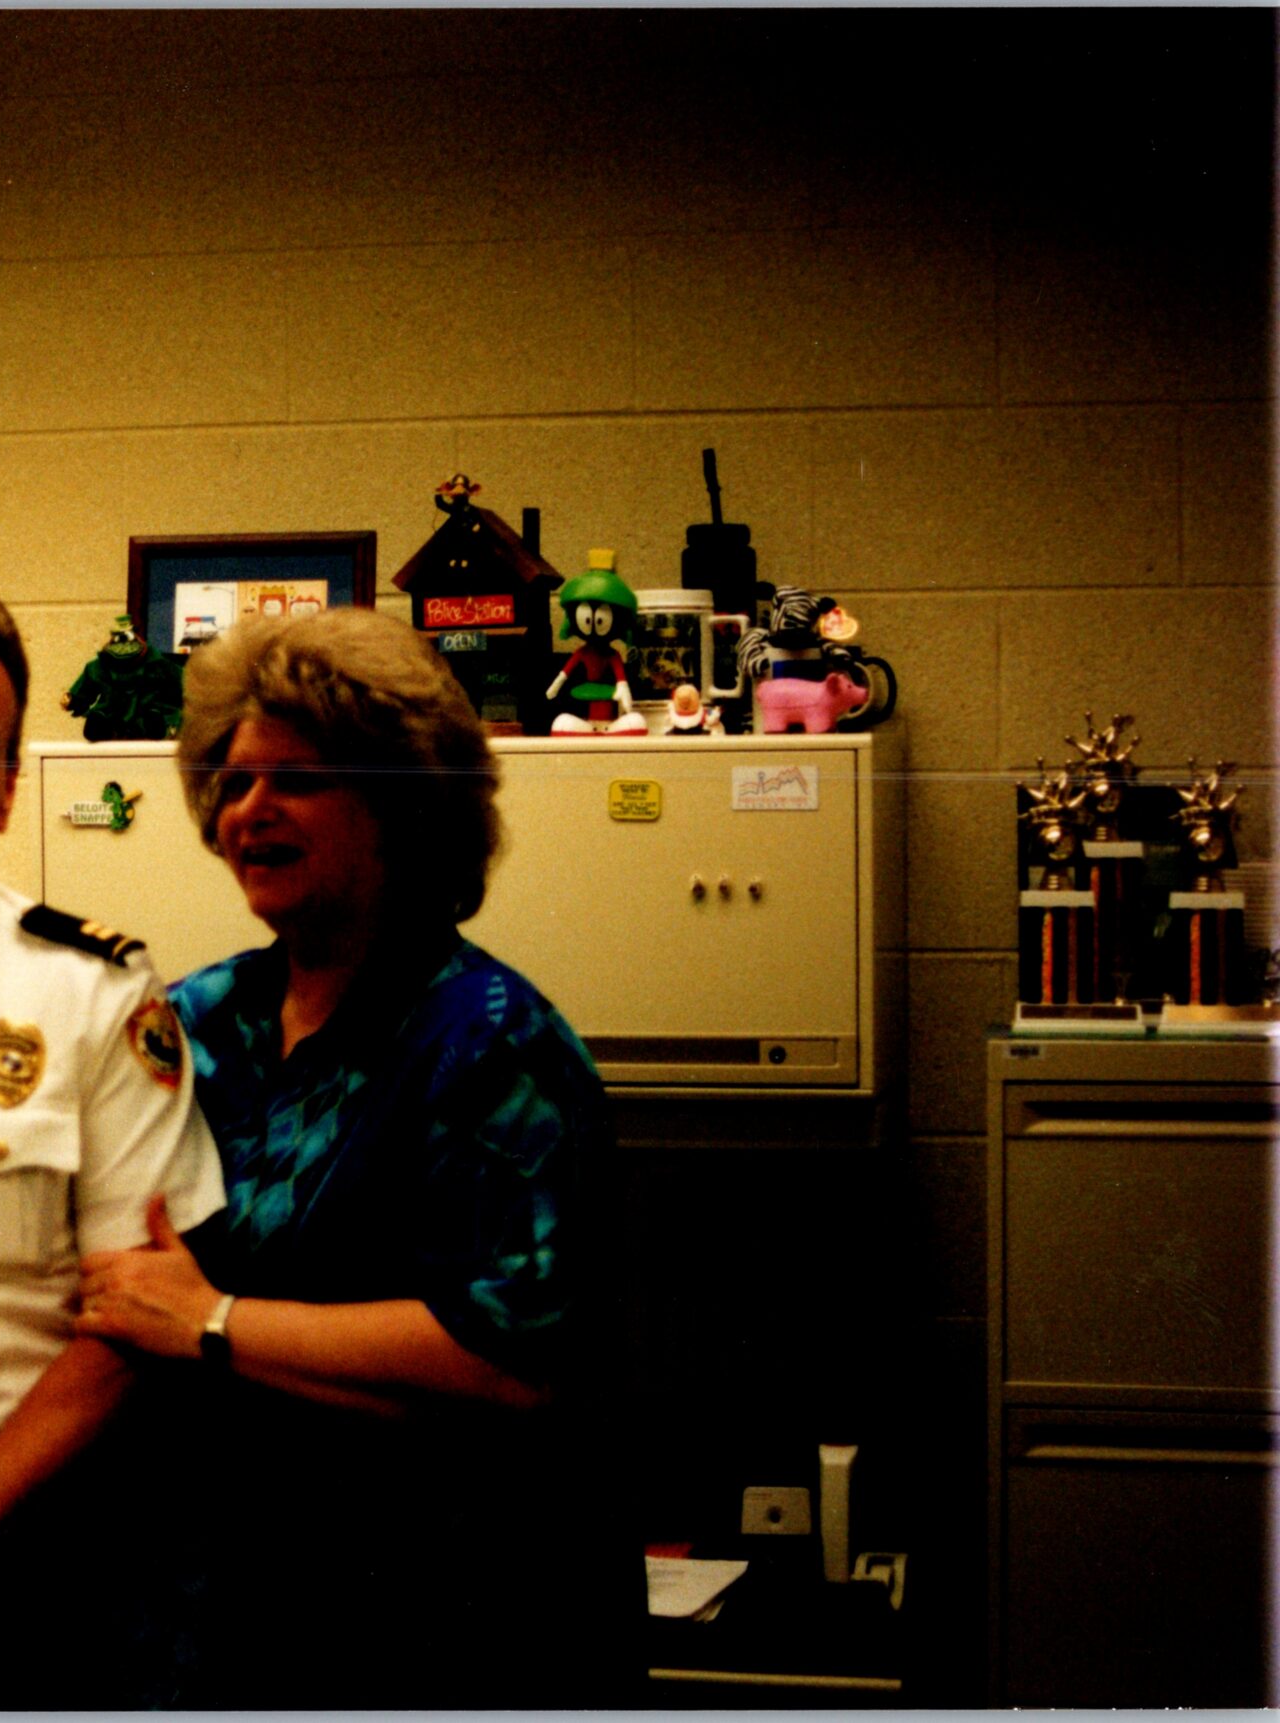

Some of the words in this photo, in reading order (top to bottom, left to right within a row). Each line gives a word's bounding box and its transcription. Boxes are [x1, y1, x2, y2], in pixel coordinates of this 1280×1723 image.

[427, 597, 463, 623] Police
[463, 595, 513, 625] Station
[443, 632, 478, 650] OPEN
